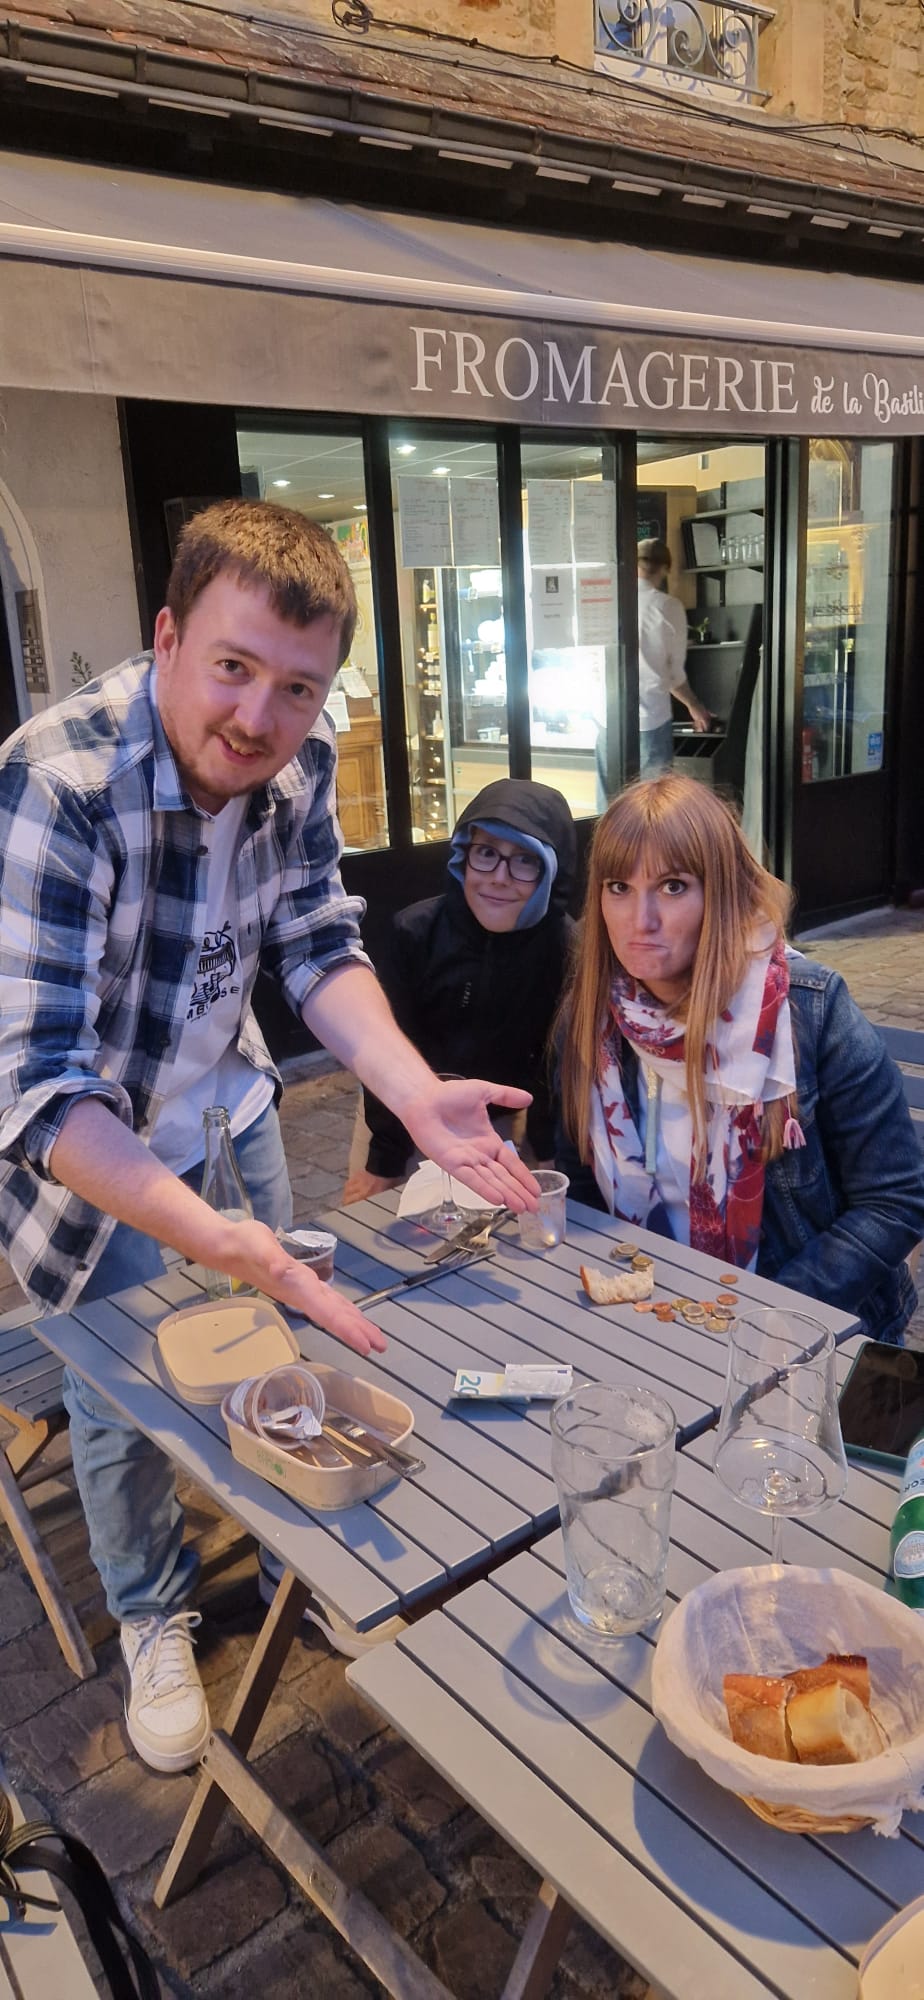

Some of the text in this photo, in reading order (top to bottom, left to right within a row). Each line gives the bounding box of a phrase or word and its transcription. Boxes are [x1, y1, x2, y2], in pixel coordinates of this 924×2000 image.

[410, 326, 799, 414] FROMAGERIE
[811, 375, 834, 413] de
[843, 381, 862, 414] la
